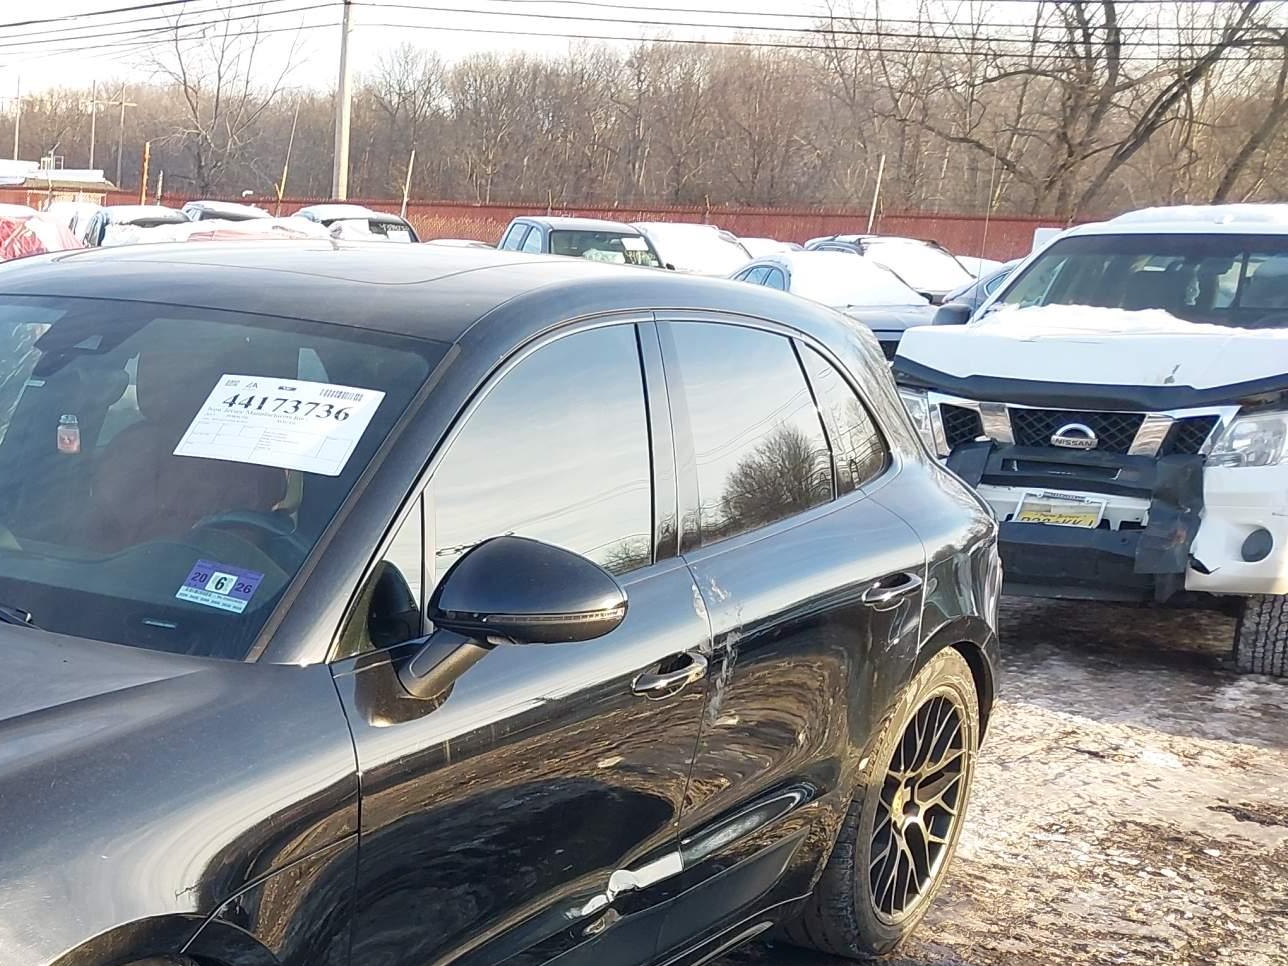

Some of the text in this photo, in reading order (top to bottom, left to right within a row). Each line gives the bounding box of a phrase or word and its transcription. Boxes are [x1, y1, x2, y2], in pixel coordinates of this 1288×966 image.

[222, 393, 354, 422] 44173736
[1055, 438, 1092, 447] NISSAN
[192, 572, 253, 594] 20 6 26
